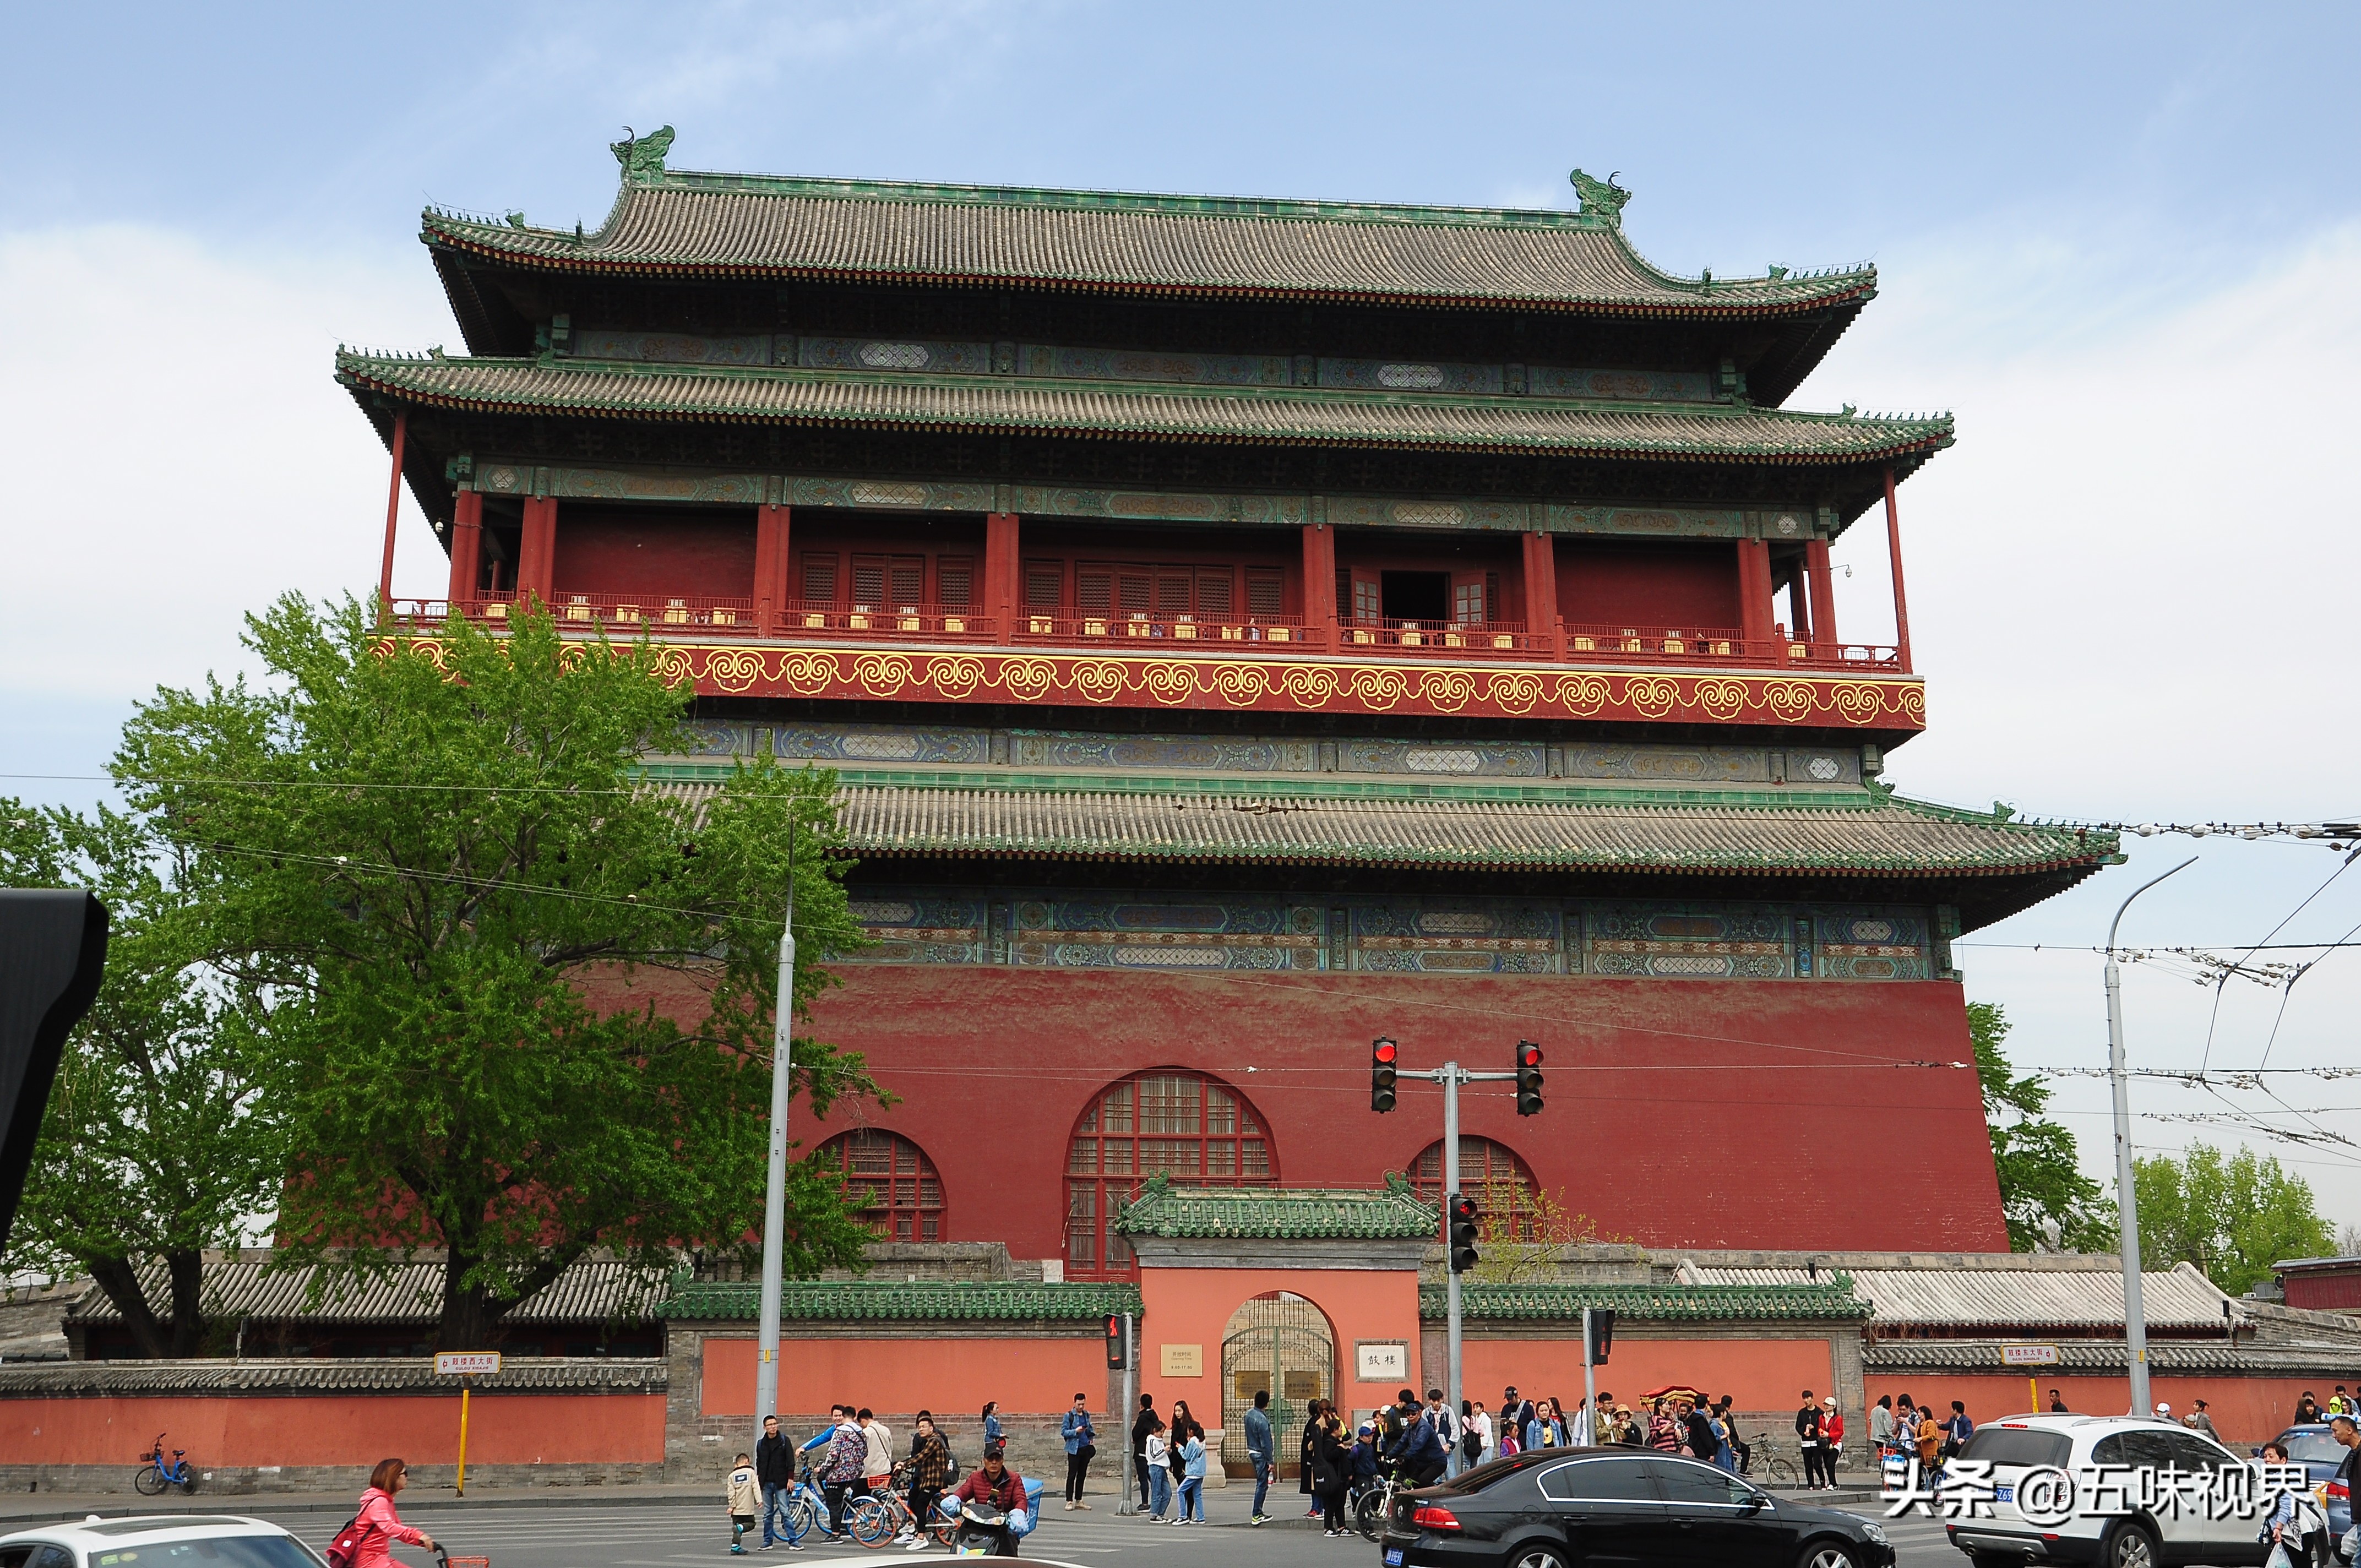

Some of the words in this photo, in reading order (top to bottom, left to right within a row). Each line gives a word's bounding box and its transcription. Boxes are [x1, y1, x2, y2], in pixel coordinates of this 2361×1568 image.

[2008, 1348, 2043, 1357] 鼓楼东大街
[452, 1357, 493, 1365] 鼓楼西大街
[1368, 1355, 1396, 1365] 鼓楼
